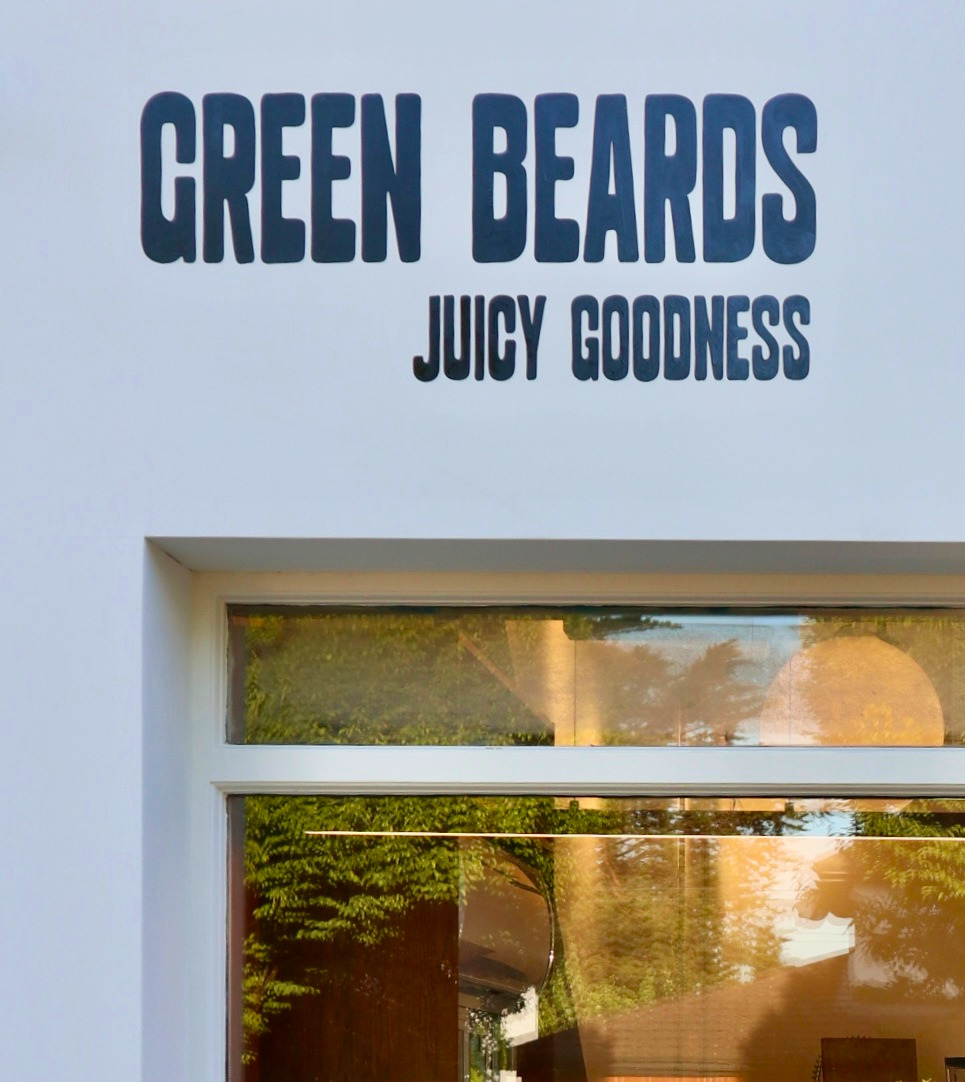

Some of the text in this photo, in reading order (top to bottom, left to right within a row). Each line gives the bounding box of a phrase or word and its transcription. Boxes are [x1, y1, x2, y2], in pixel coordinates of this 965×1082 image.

[140, 91, 818, 264] GREEN BEARDS
[412, 295, 811, 382] JUICY GOODNESS
